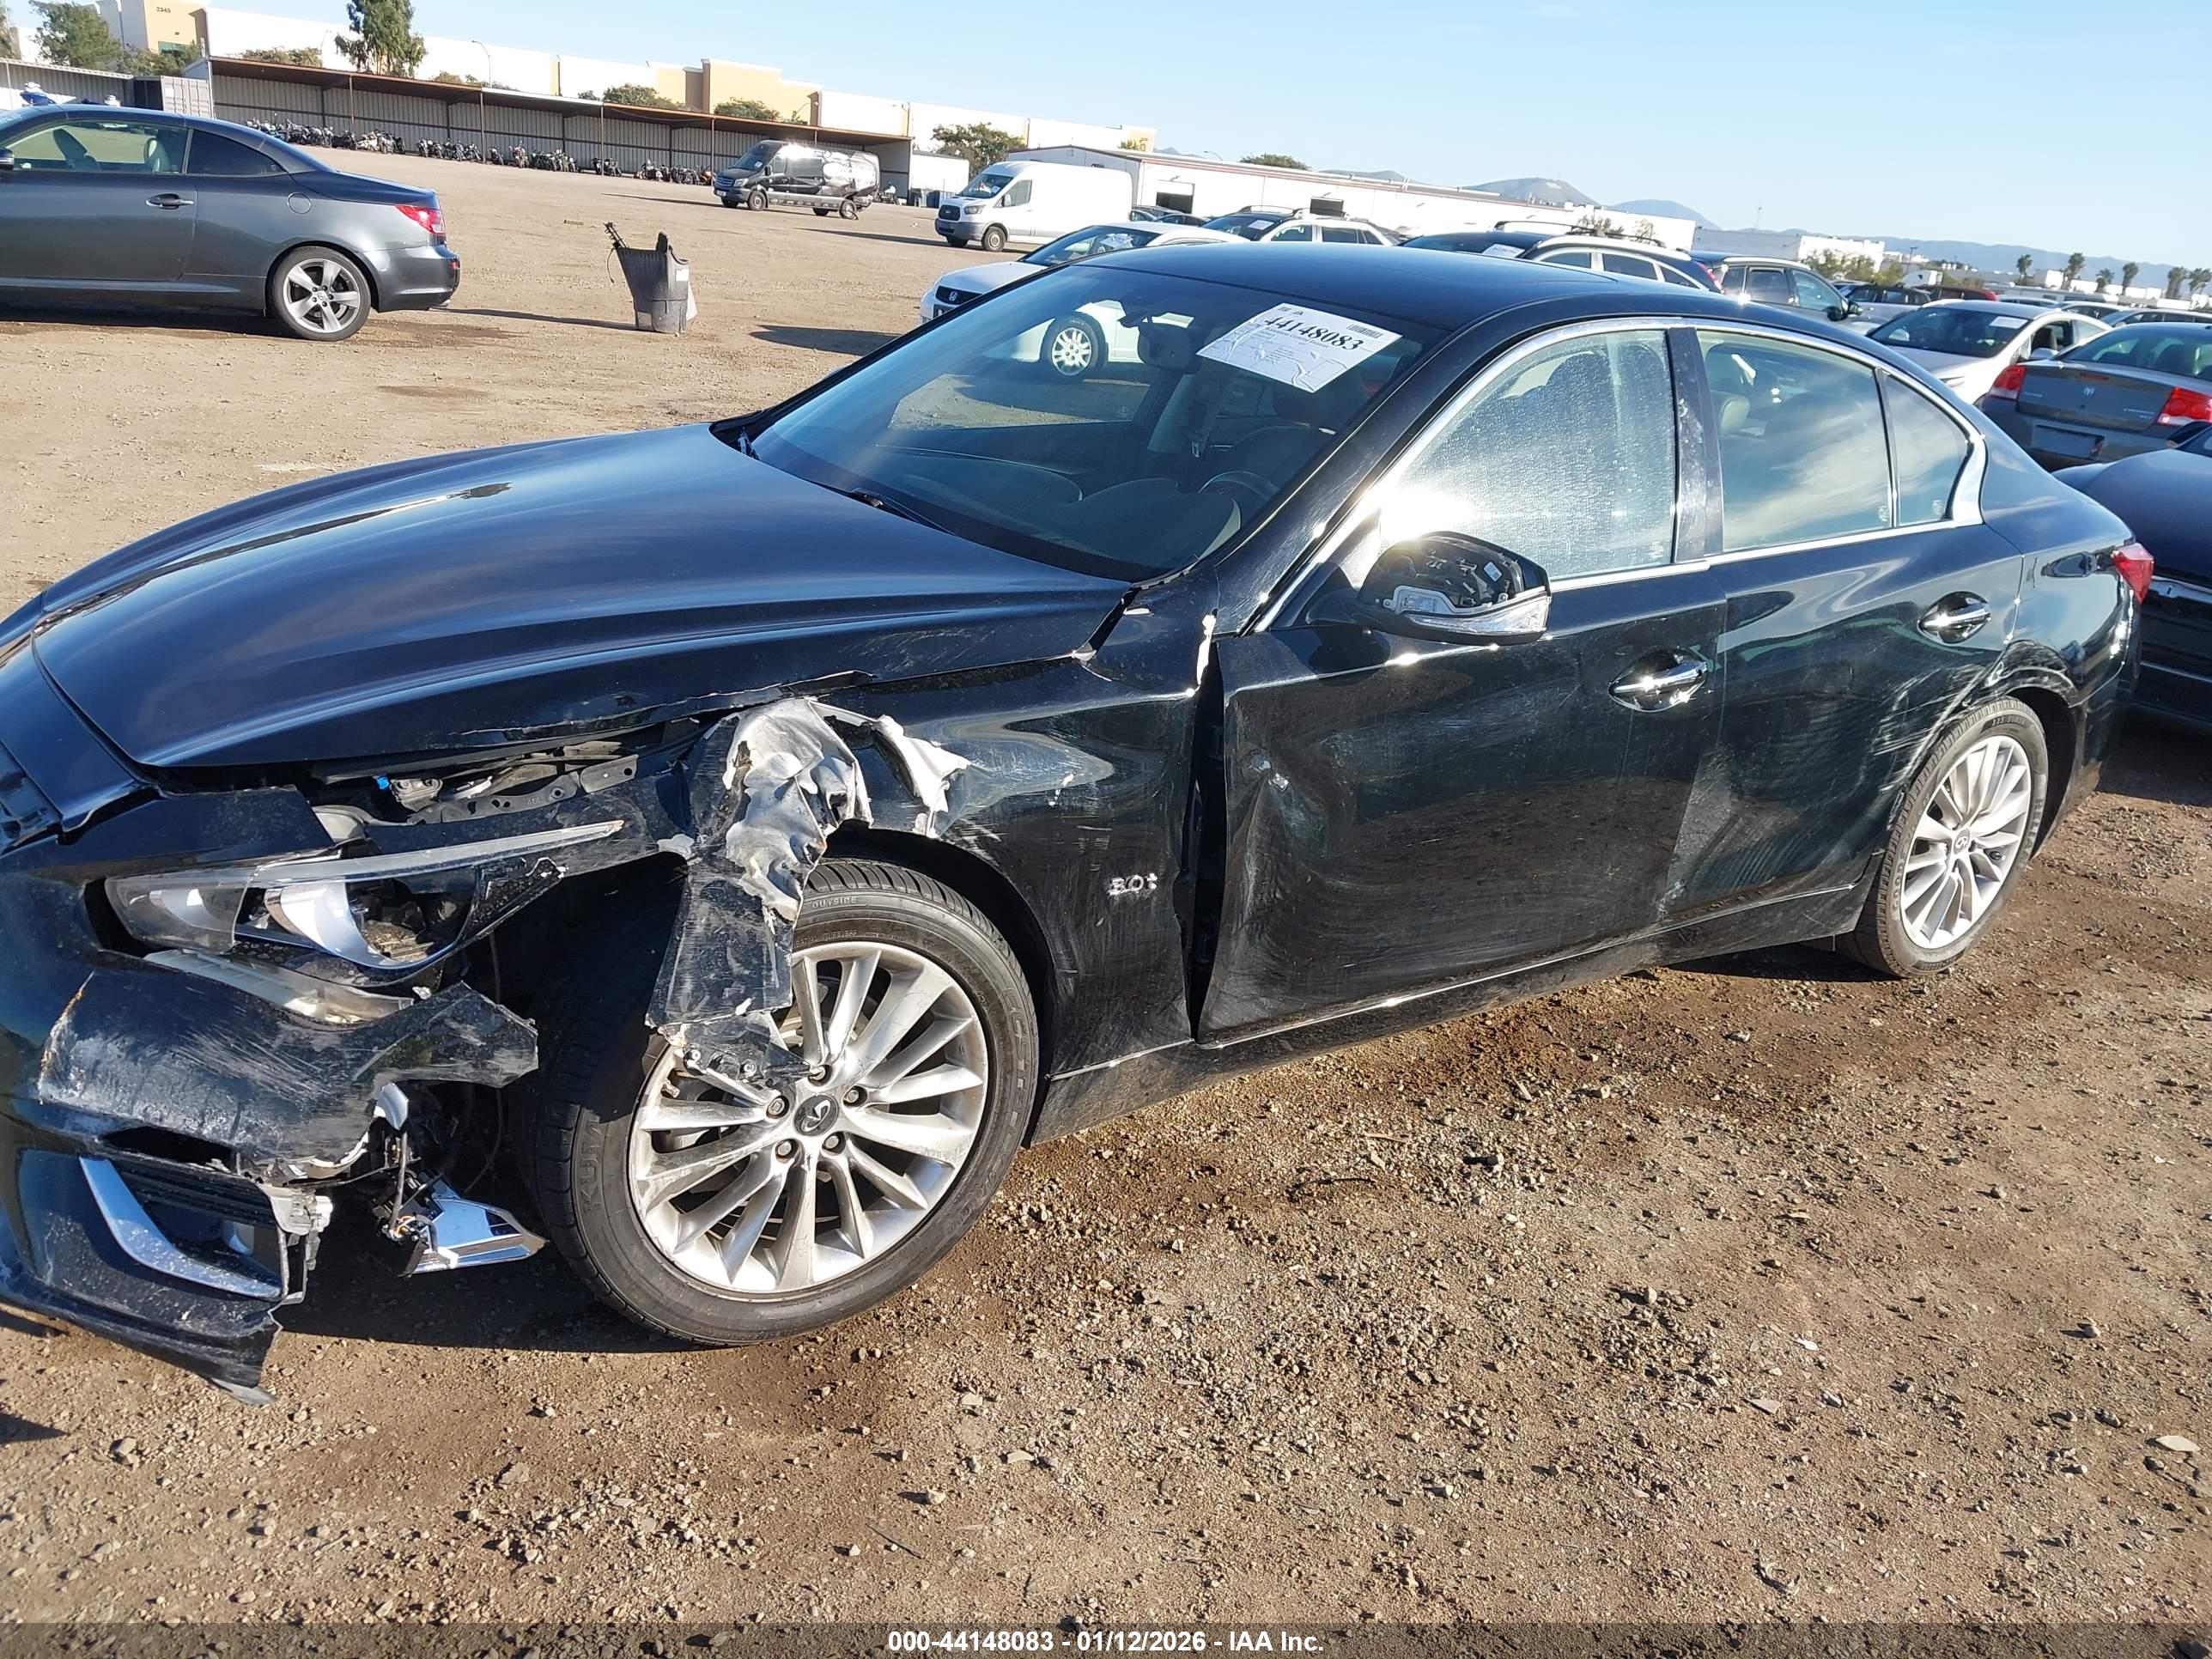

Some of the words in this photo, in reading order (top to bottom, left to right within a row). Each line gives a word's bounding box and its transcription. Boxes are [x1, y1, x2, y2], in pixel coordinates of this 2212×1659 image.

[1264, 316, 1364, 350] 44148083
[811, 896, 858, 909] OUTSIDE
[580, 1119, 603, 1213] KUM
